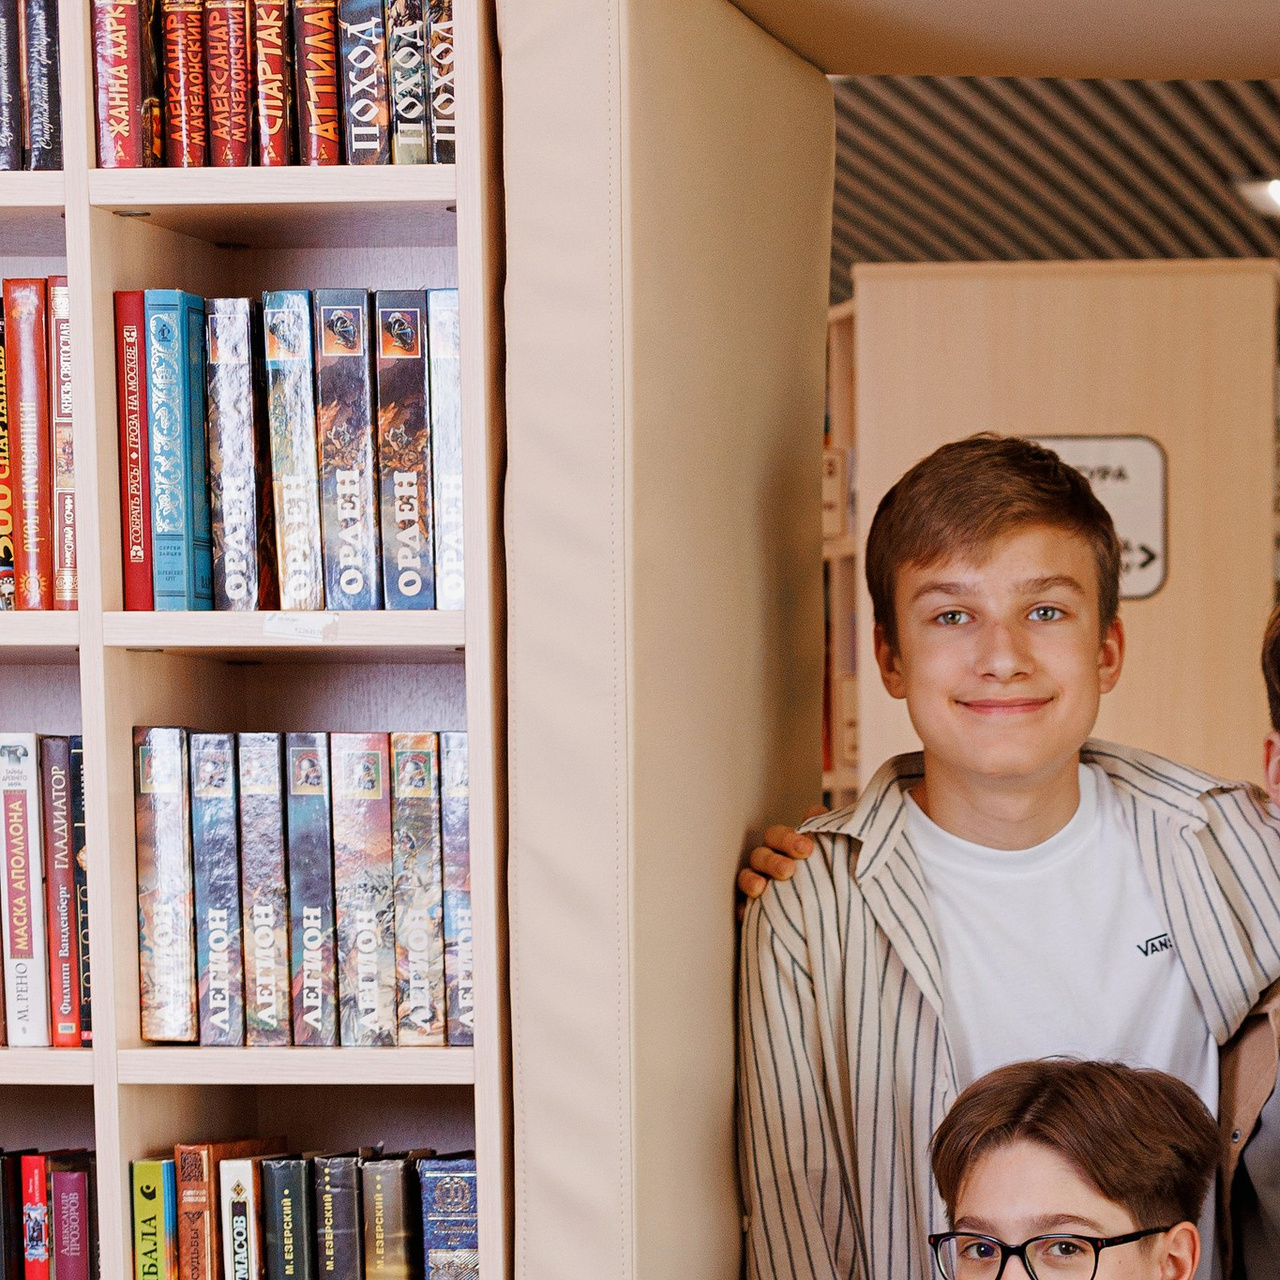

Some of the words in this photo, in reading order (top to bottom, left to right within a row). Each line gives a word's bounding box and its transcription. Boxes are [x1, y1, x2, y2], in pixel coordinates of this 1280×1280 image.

[105, 5, 130, 59] ДАРК
[256, 7, 284, 135] СПАРТАК
[108, 64, 130, 137] ЖАННА
[166, 14, 189, 142] АЛЕКСАНДР
[187, 13, 206, 147] МАКЕДОНСКИЙ
[208, 11, 231, 141] АЛЕКСАНДР
[229, 8, 247, 144] МАКЕДОНСКИЙ
[304, 9, 339, 142] АТТИЛА
[347, 17, 382, 152] ПОХОД
[393, 20, 424, 148] ПОХОД
[430, 21, 456, 143] ПОХОД
[62, 385, 72, 414] КНЯЗЬ
[126, 346, 138, 392] МОСКВЕ
[127, 393, 138, 411] НА
[127, 413, 139, 449] ГРОЗА
[64, 495, 76, 525] КОЧИН
[128, 464, 140, 495] РУСЬ!
[128, 497, 142, 544] СОБРАТЬ
[64, 529, 76, 569] НИКОЛАЙ
[336, 469, 364, 595] ОРДЕН
[393, 470, 422, 597] ОРДЕН
[9, 799, 26, 891] АПОЛЛОНА
[51, 764, 69, 869] ГЛАДИАТОР
[12, 895, 29, 951] МАСКА
[58, 884, 71, 958] Ванденберг
[16, 963, 28, 999] РЕНО
[59, 962, 72, 1016] Филипп
[208, 908, 229, 1033] ЛЕГИОН
[253, 904, 278, 1029] ЛЕГИОН
[303, 905, 322, 1031] ЛЕГИОН
[69, 1192, 80, 1257] ПРОЗОРОВ
[189, 1228, 201, 1280] СУДЬБЫ
